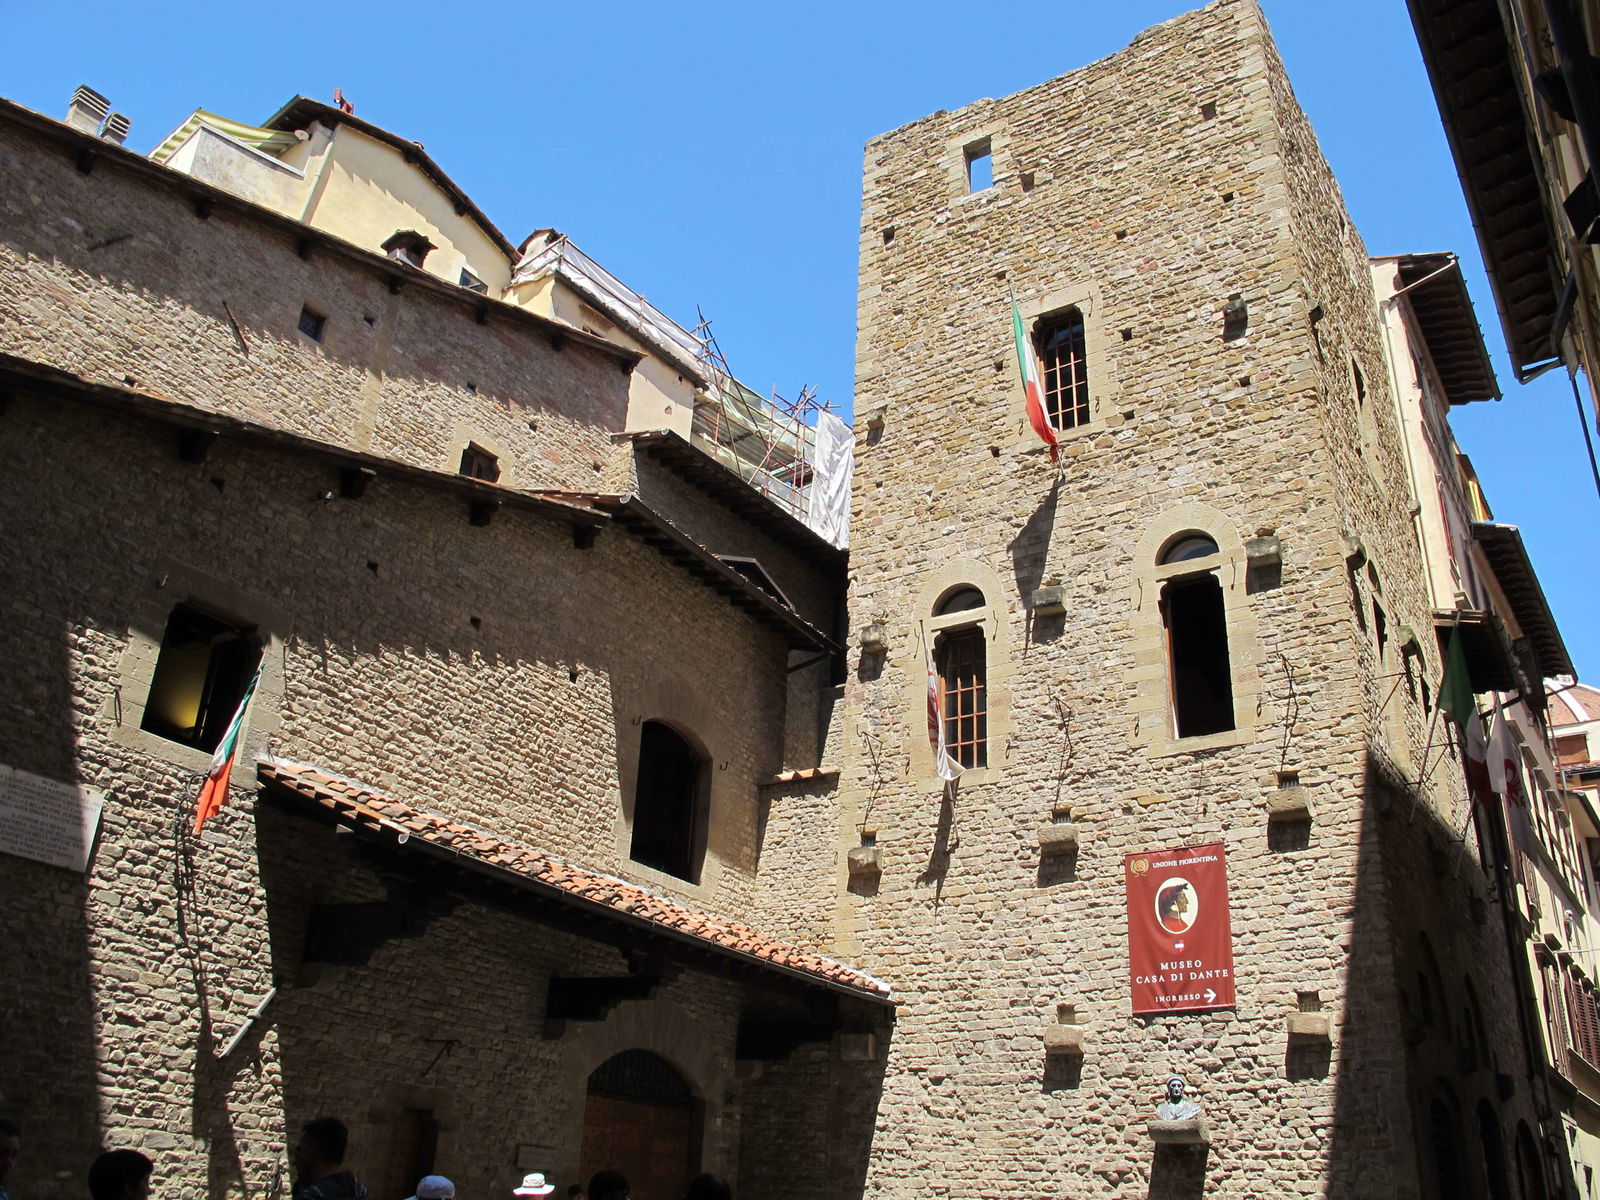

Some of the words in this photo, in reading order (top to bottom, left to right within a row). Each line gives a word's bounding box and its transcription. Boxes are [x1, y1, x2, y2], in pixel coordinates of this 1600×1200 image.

[1152, 859, 1178, 869] UNIONE
[1179, 855, 1218, 866] FIORENTINA
[1160, 959, 1202, 970] MUSEO
[1136, 973, 1165, 984] CASA
[1171, 972, 1183, 982] DI
[1190, 969, 1229, 980] DANTE
[1155, 993, 1201, 1003] INGRESSO
